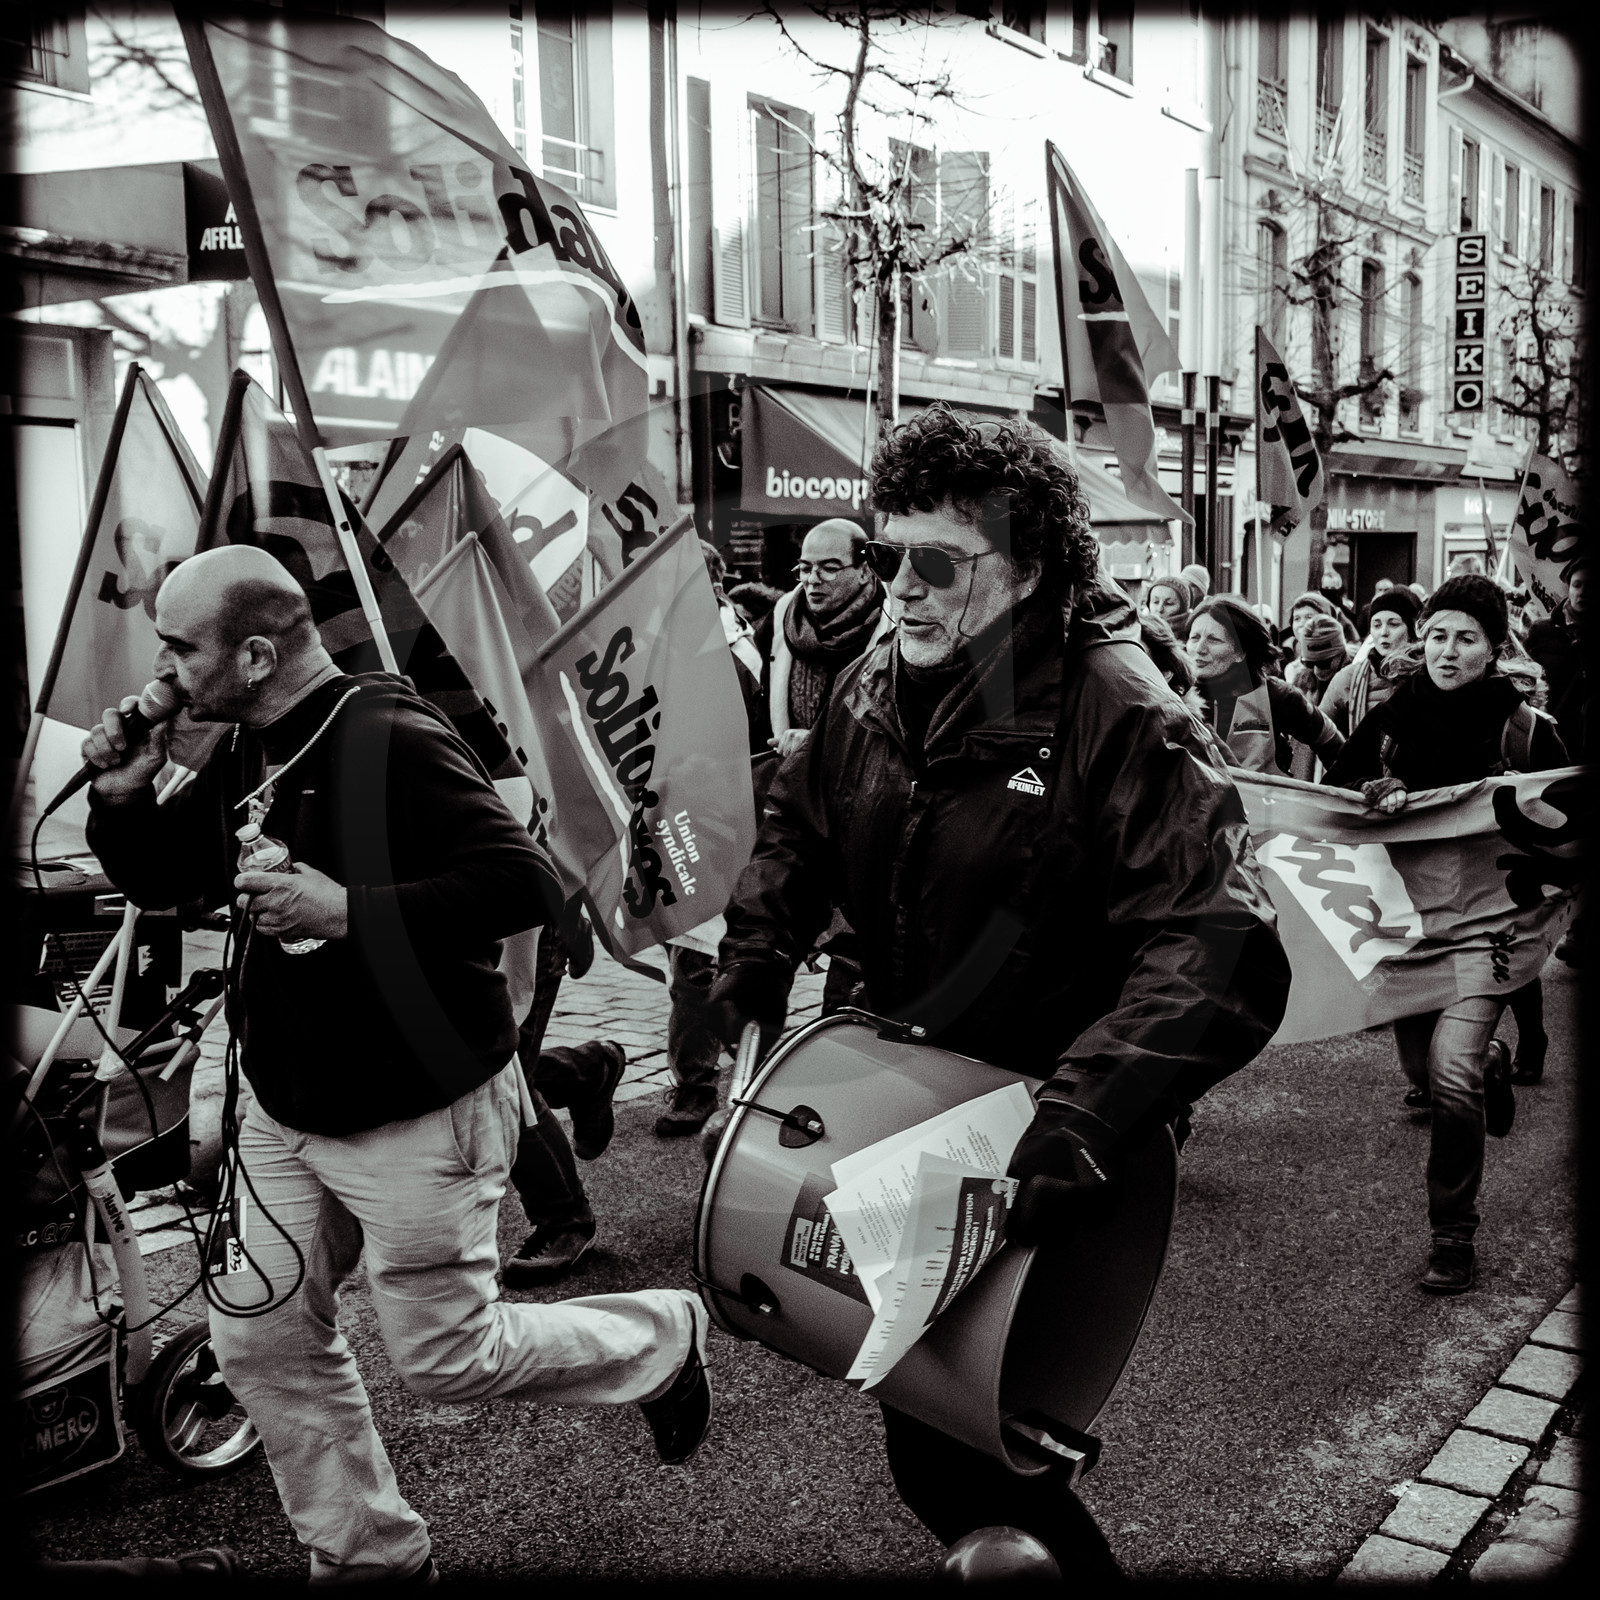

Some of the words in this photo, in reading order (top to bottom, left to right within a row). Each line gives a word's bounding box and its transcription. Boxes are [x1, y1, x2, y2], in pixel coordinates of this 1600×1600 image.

[1457, 236, 1486, 411] SEIKO
[765, 466, 869, 511] biocoop
[656, 817, 697, 897] syndicale
[671, 810, 702, 864] Union
[41, 1221, 76, 1244] Q7
[966, 1226, 980, 1265] MACRON
